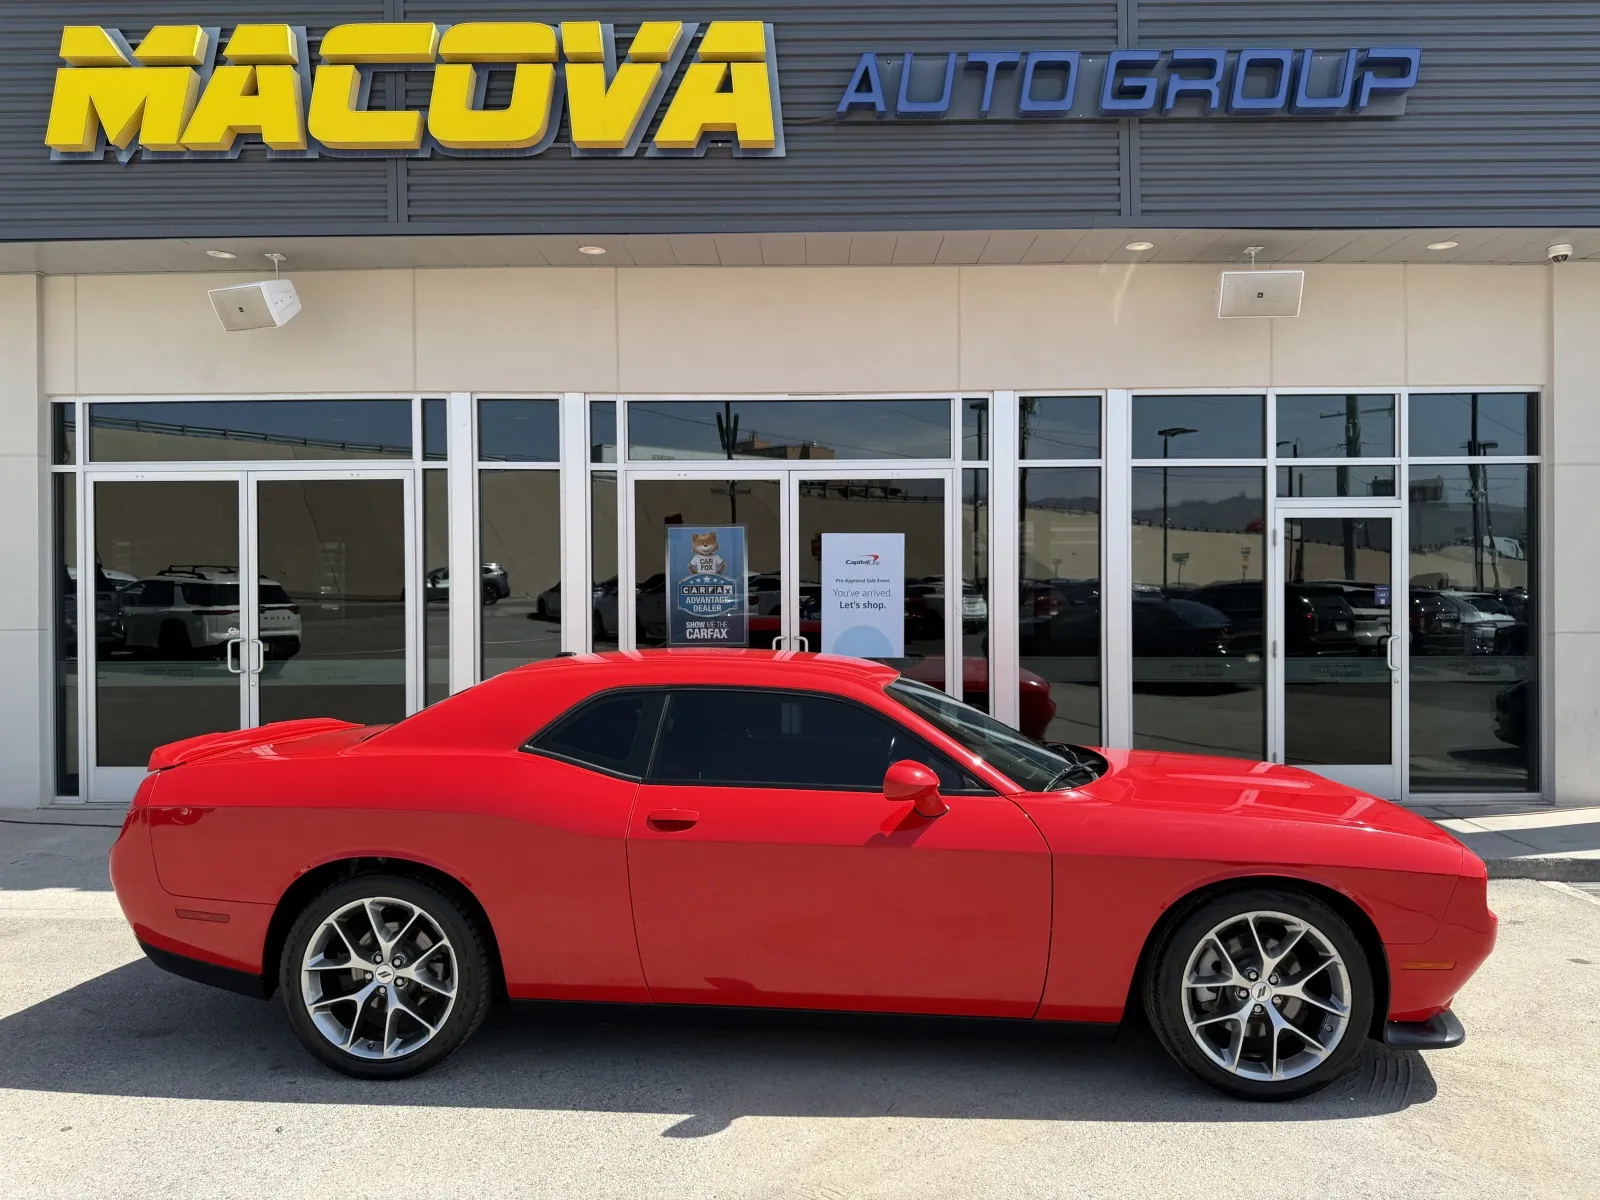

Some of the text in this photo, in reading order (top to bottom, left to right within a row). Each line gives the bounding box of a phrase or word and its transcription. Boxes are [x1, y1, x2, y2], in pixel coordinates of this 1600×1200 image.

[45, 21, 776, 153] MACOVA
[836, 47, 1422, 118] AUTO GROUP
[682, 586, 731, 594] CARFAX
[833, 588, 892, 597] You've arrived.
[686, 596, 729, 604] ADVANTAGE
[693, 604, 721, 612] DEALER
[839, 601, 886, 611] Let's shop.
[686, 628, 728, 639] CARFAX
